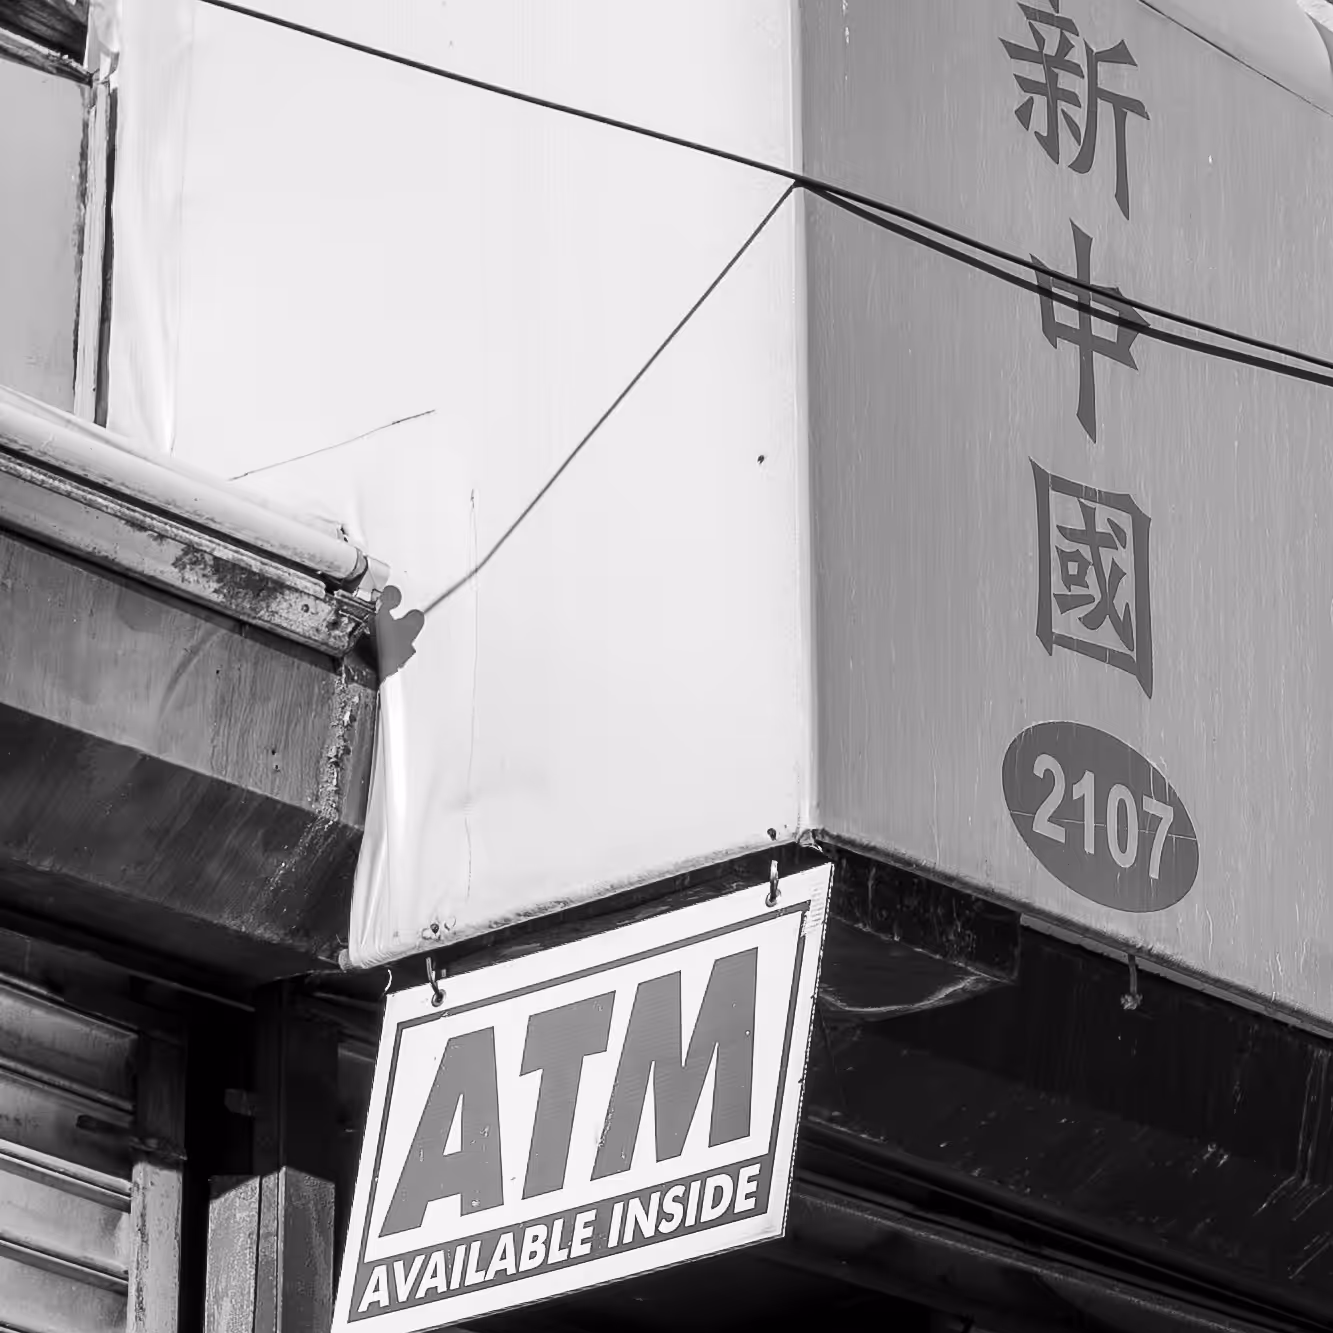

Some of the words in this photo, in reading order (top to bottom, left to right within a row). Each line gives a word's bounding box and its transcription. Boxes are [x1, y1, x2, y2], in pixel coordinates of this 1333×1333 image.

[998, 0, 1154, 699] 新中國
[1031, 753, 1176, 880] 2107
[378, 946, 759, 1239] ATM
[357, 1208, 598, 1314] AVAILABLE
[606, 1162, 762, 1249] INSIDE
